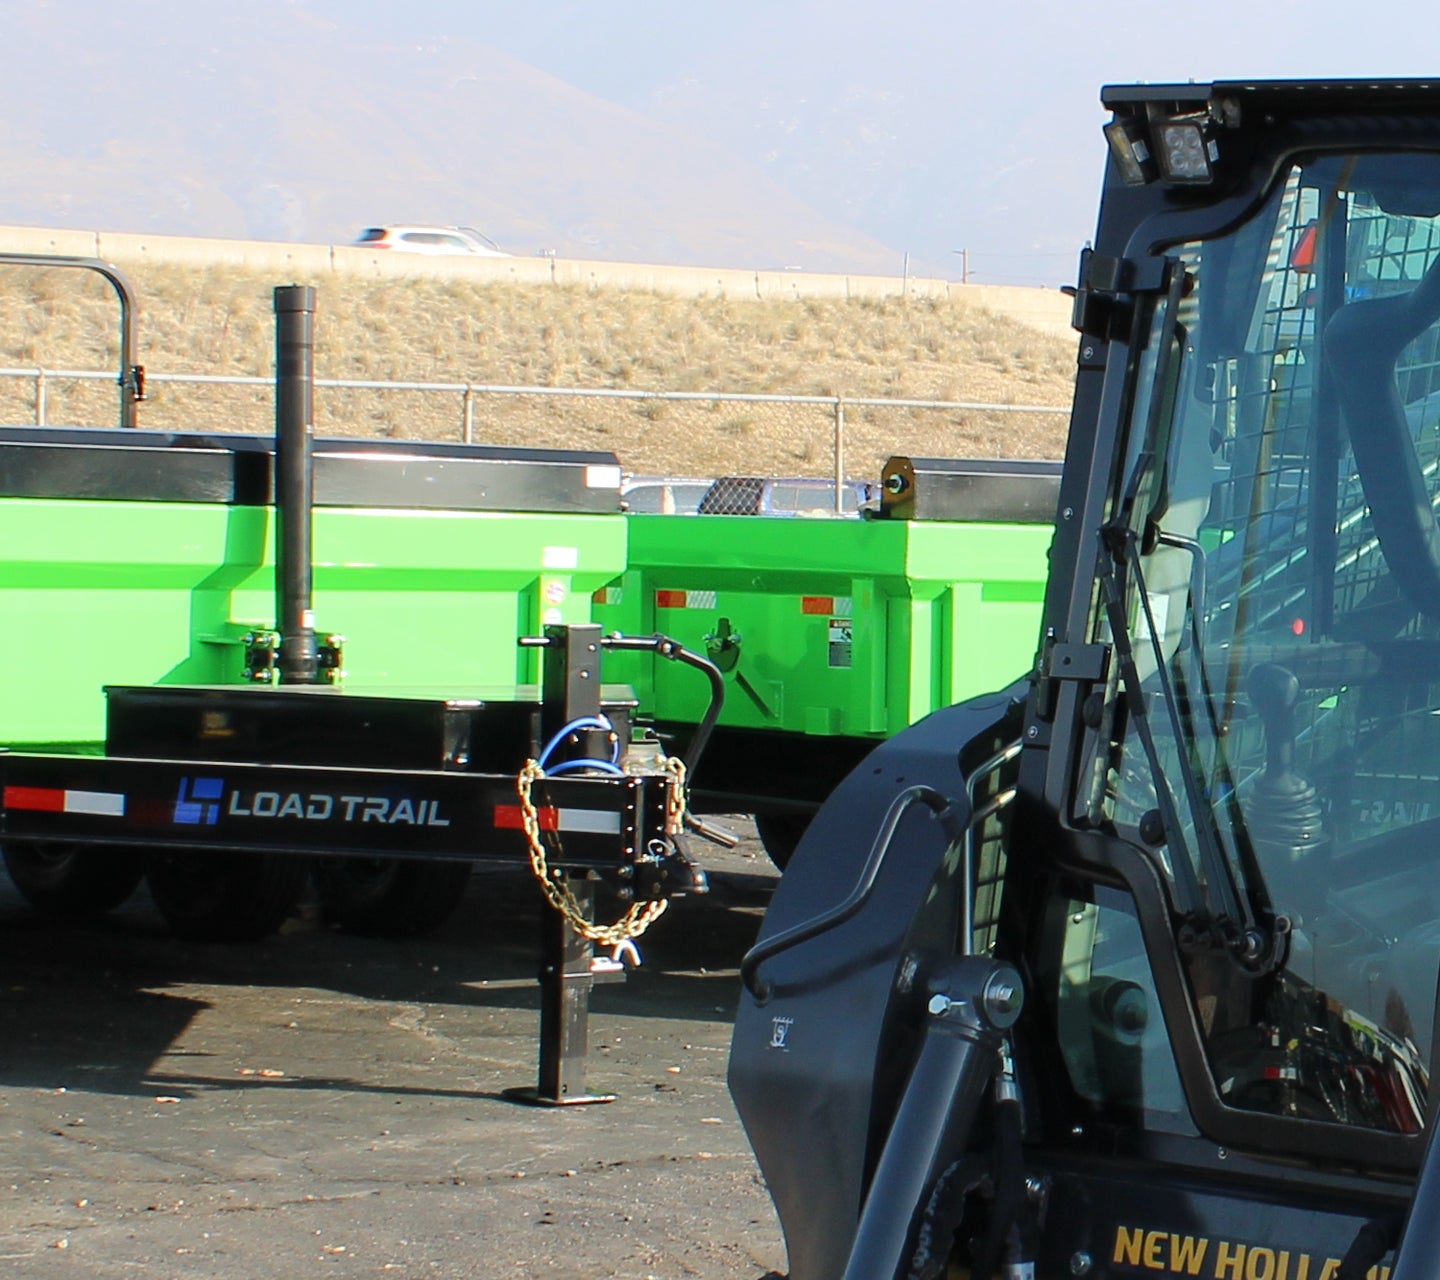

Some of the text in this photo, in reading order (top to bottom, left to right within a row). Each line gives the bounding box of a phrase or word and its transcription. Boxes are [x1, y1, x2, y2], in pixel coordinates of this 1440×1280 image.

[229, 790, 450, 826] LOAD TRAIL
[1113, 1226, 1208, 1276] NEW
